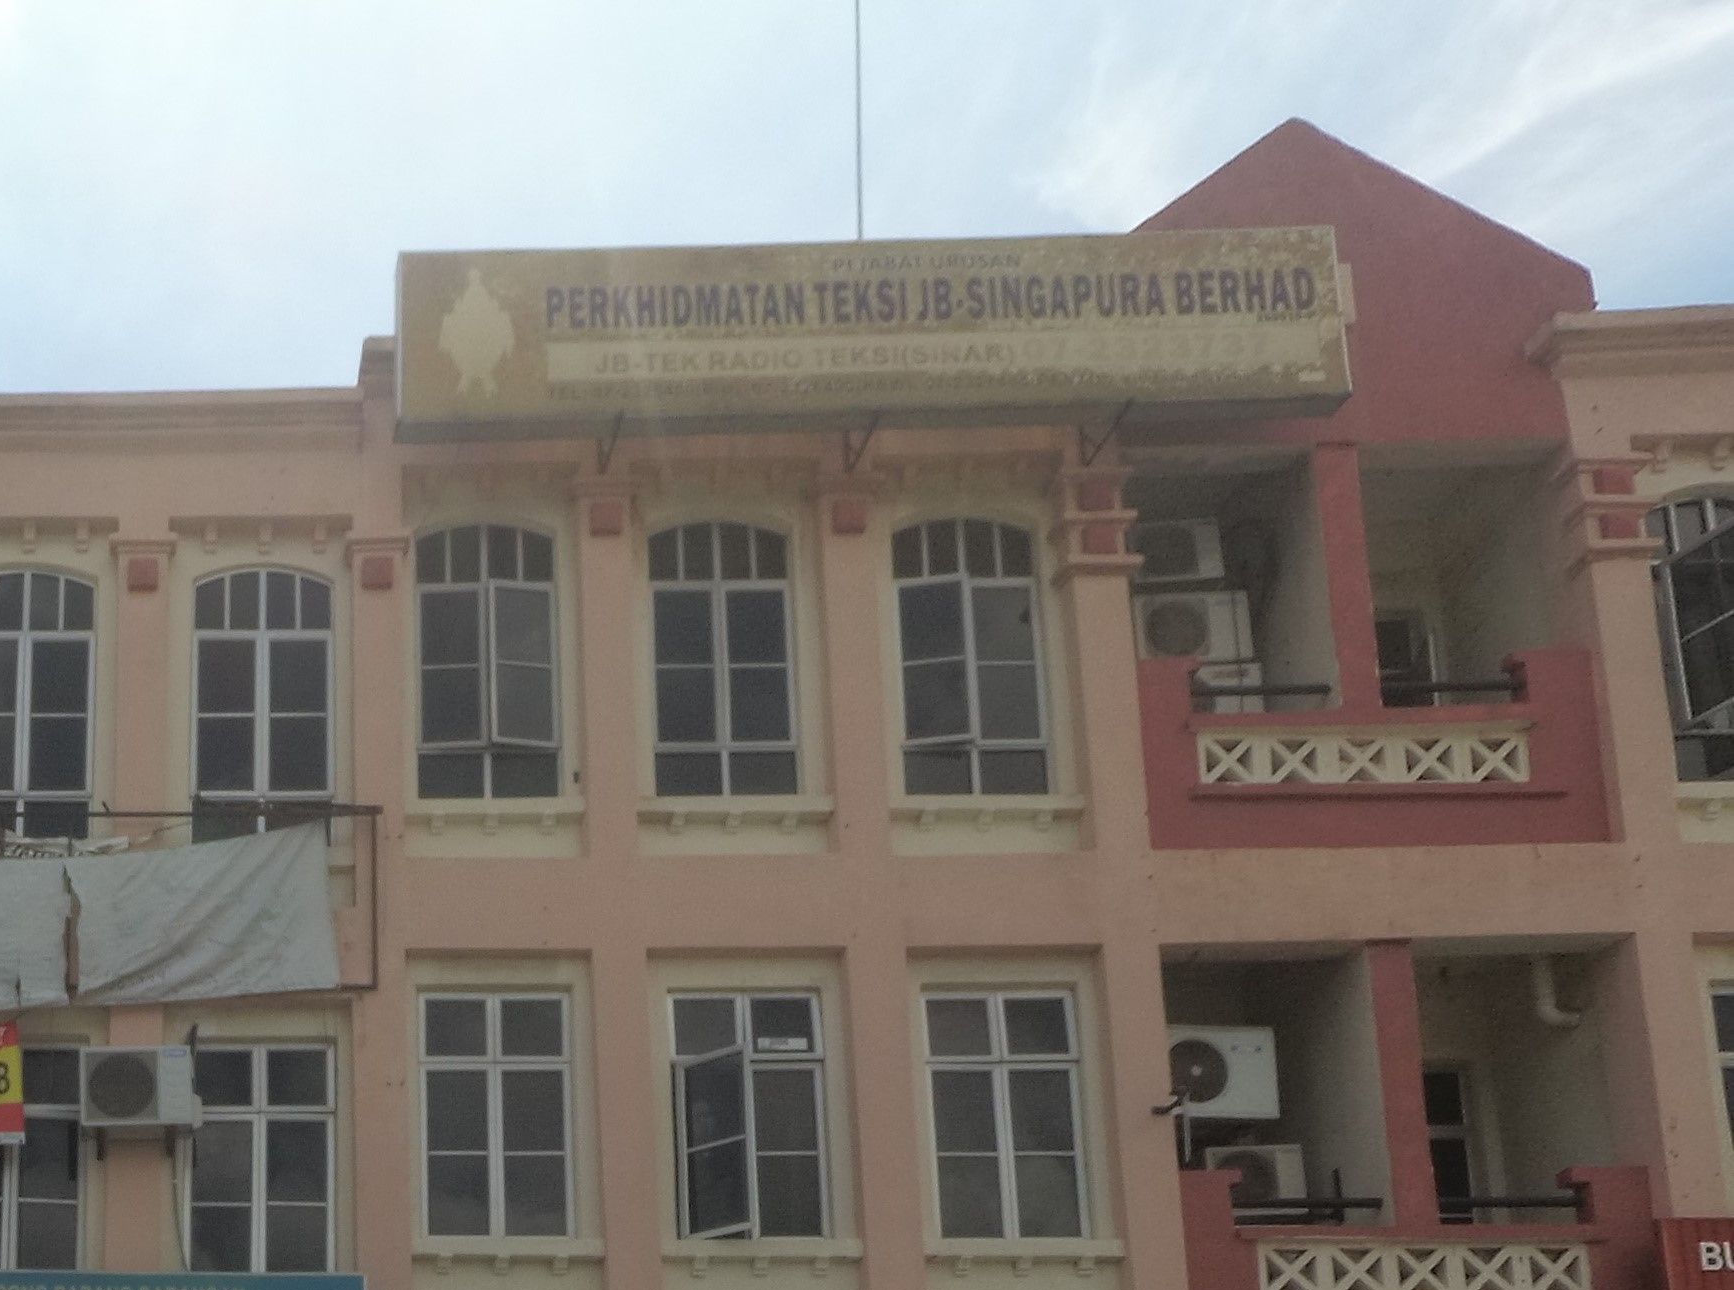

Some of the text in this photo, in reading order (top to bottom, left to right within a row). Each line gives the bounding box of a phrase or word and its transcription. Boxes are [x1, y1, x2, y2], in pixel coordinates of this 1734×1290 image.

[546, 268, 1315, 328] PERKHIDMATAN TEKSI JB-SINGAPURA BERHAD
[594, 351, 700, 375] JB-TEK
[708, 348, 803, 373] RADIO
